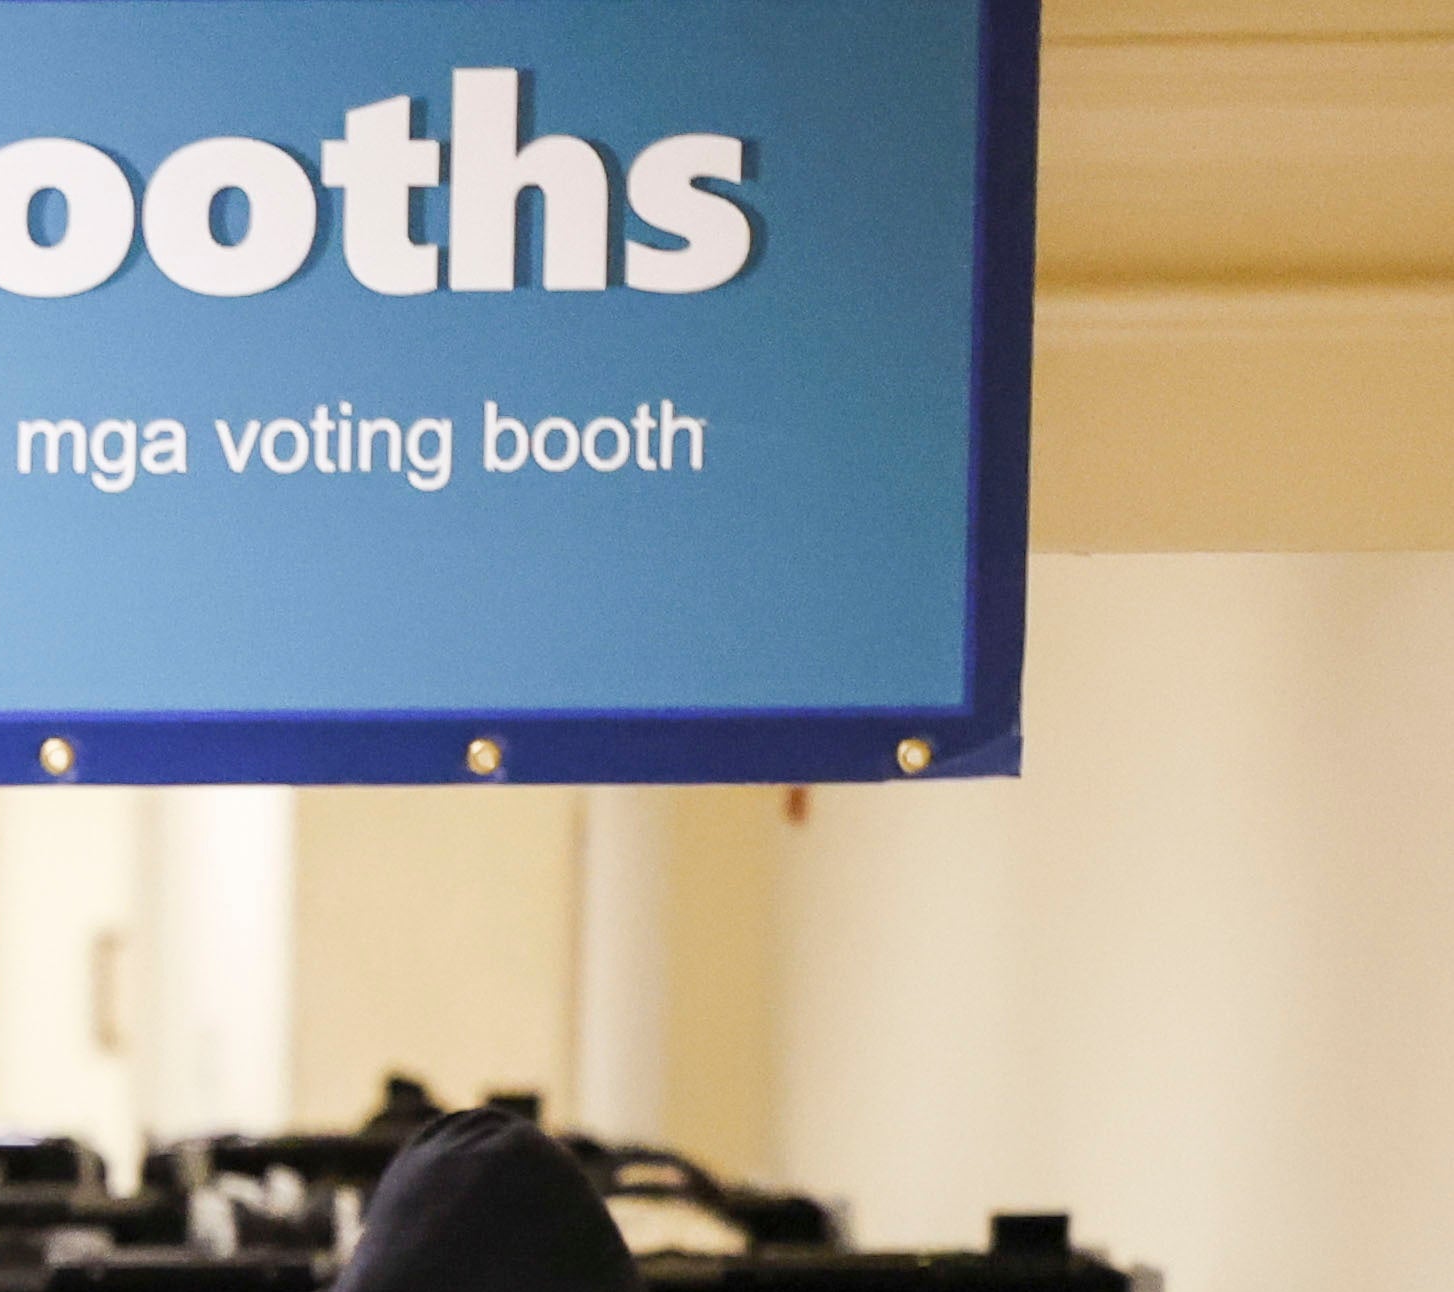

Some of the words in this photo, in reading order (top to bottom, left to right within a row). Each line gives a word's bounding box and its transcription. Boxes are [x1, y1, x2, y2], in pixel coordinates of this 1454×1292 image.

[16, 417, 188, 495] mga
[214, 400, 454, 493] voting
[482, 399, 707, 474] booth
